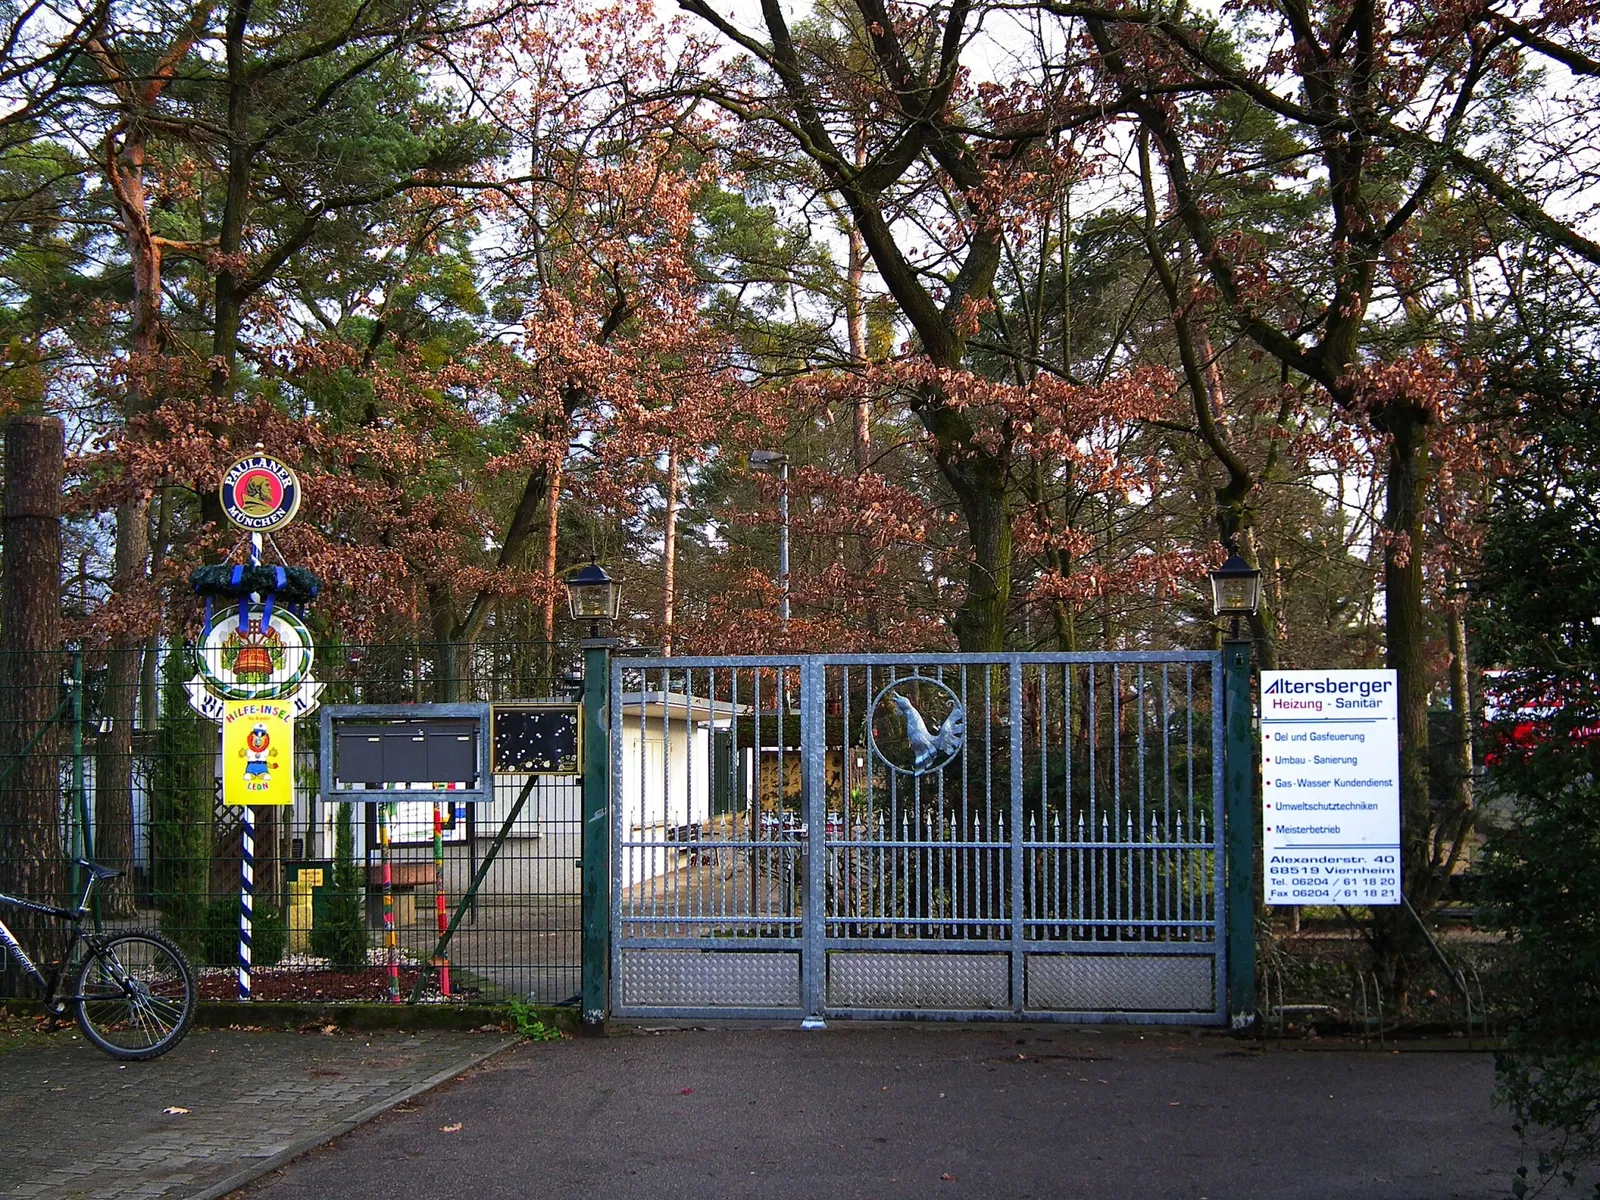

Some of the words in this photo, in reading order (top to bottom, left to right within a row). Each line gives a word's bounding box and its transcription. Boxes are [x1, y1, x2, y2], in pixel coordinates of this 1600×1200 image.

[224, 457, 293, 489] PAULANER
[227, 505, 287, 527] MÜNCHEN
[1264, 677, 1392, 697] Altersberger
[1273, 698, 1323, 711] Heizung
[1335, 697, 1383, 709] Sanitär
[226, 704, 291, 723] HILFE-INSEL
[1274, 732, 1288, 741] Oel
[1291, 732, 1307, 741] und
[1309, 731, 1365, 743] Gasfeuerung
[1275, 755, 1306, 765] Umbau
[1313, 754, 1358, 766] Sanierung
[247, 782, 269, 791] LEON
[1334, 777, 1393, 787] Kundendienst
[1275, 801, 1378, 811] Umweltschutztechniken
[1276, 824, 1341, 834] Meisterbetrieb
[1270, 855, 1367, 863] Alexanderstr.
[1373, 855, 1395, 863] 40
[1270, 866, 1320, 874] 68519
[1324, 866, 1395, 874] Viernheim
[1271, 878, 1288, 886] Tel.
[1291, 878, 1329, 886] 06204
[1343, 878, 1357, 886] 61
[1363, 878, 1377, 886] 18
[1380, 878, 1396, 886] 20
[1270, 889, 1289, 897] Fax
[1292, 889, 1330, 897] 06204
[1344, 889, 1358, 897] 61
[1363, 889, 1377, 897] 18
[1381, 889, 1395, 897] 21
